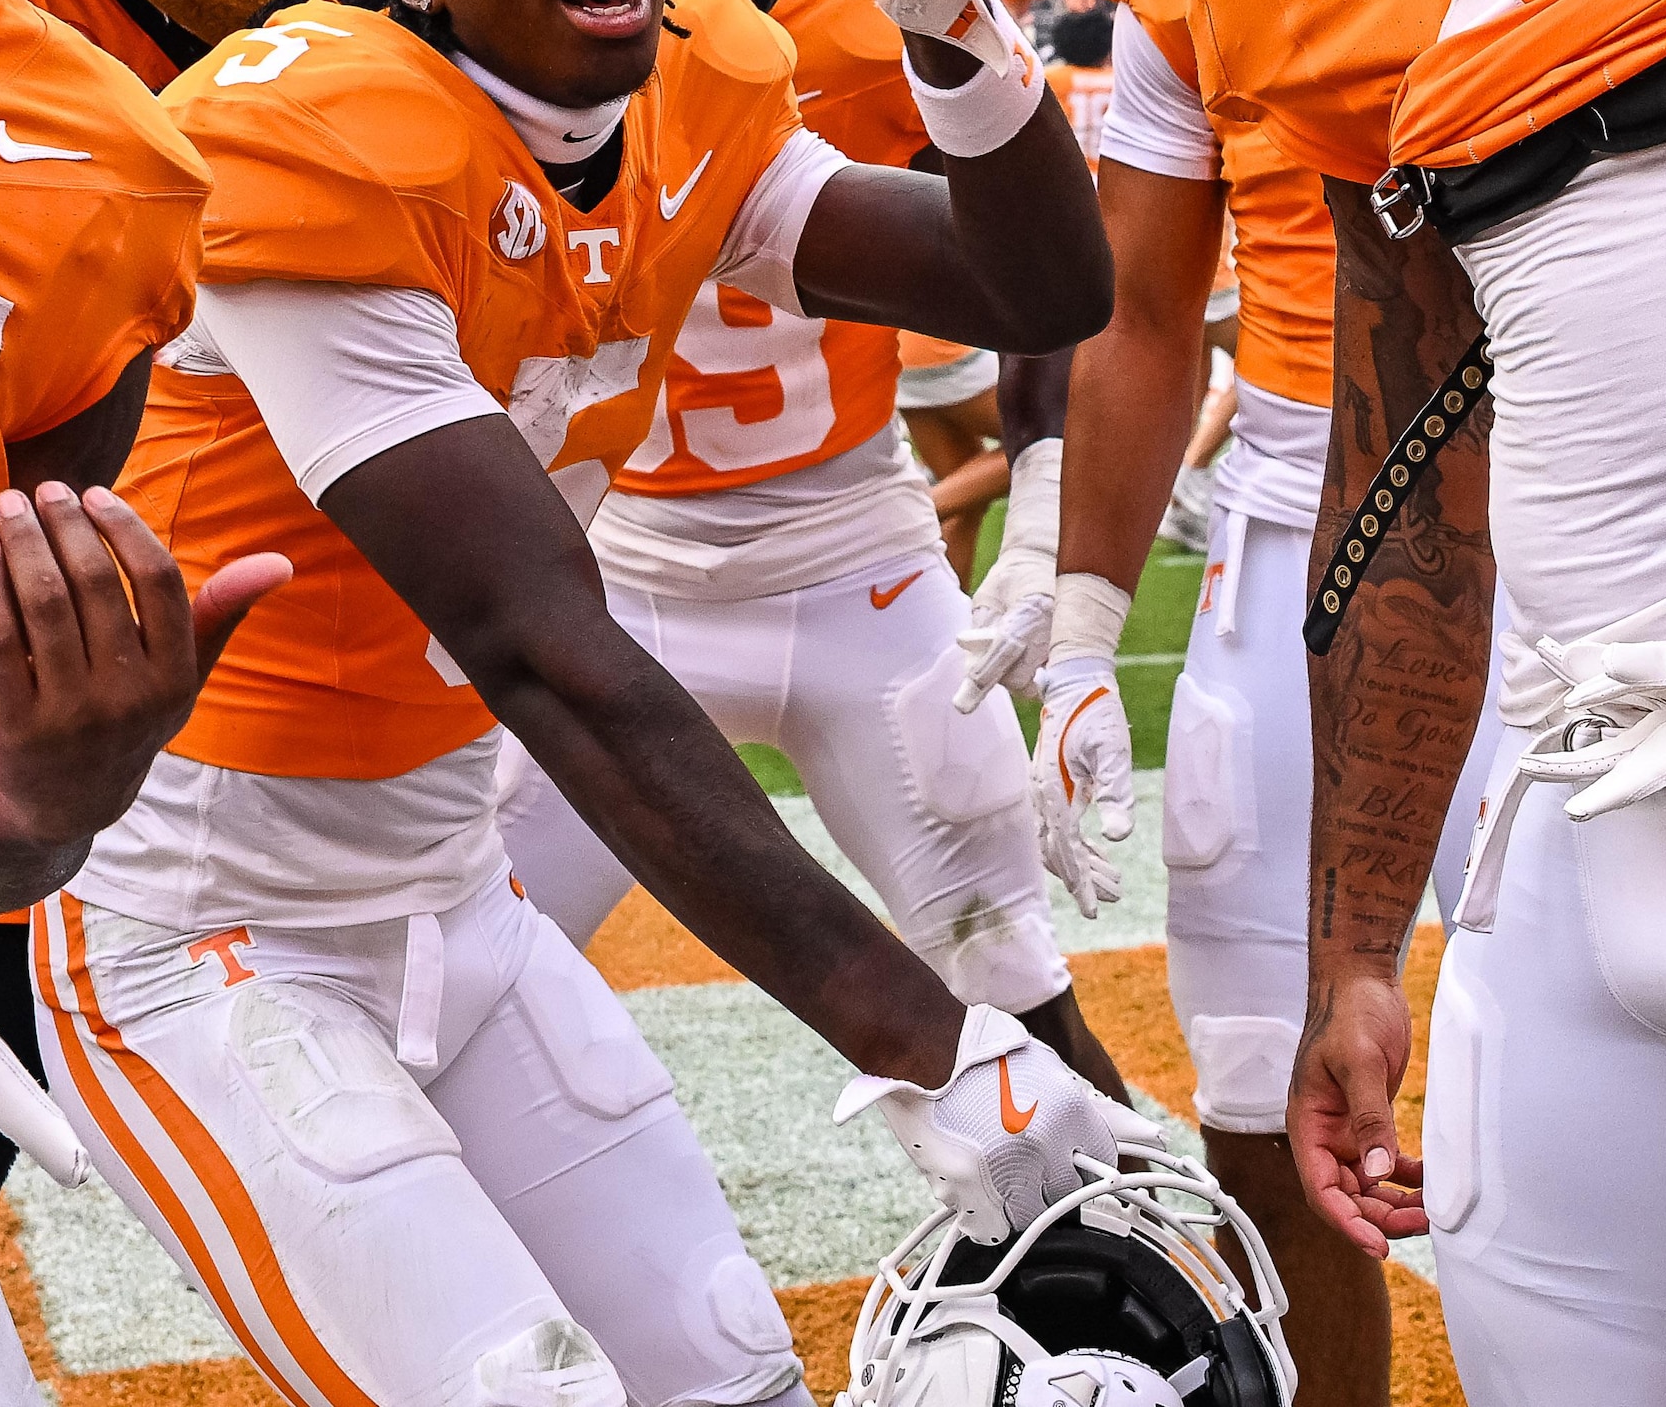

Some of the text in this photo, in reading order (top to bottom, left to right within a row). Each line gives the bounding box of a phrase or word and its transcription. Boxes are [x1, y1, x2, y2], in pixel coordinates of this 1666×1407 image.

[213, 20, 354, 87] 5
[568, 228, 620, 284] T
[1372, 638, 1461, 684] Love
[1340, 844, 1430, 890] PRA
[187, 925, 261, 989] T
